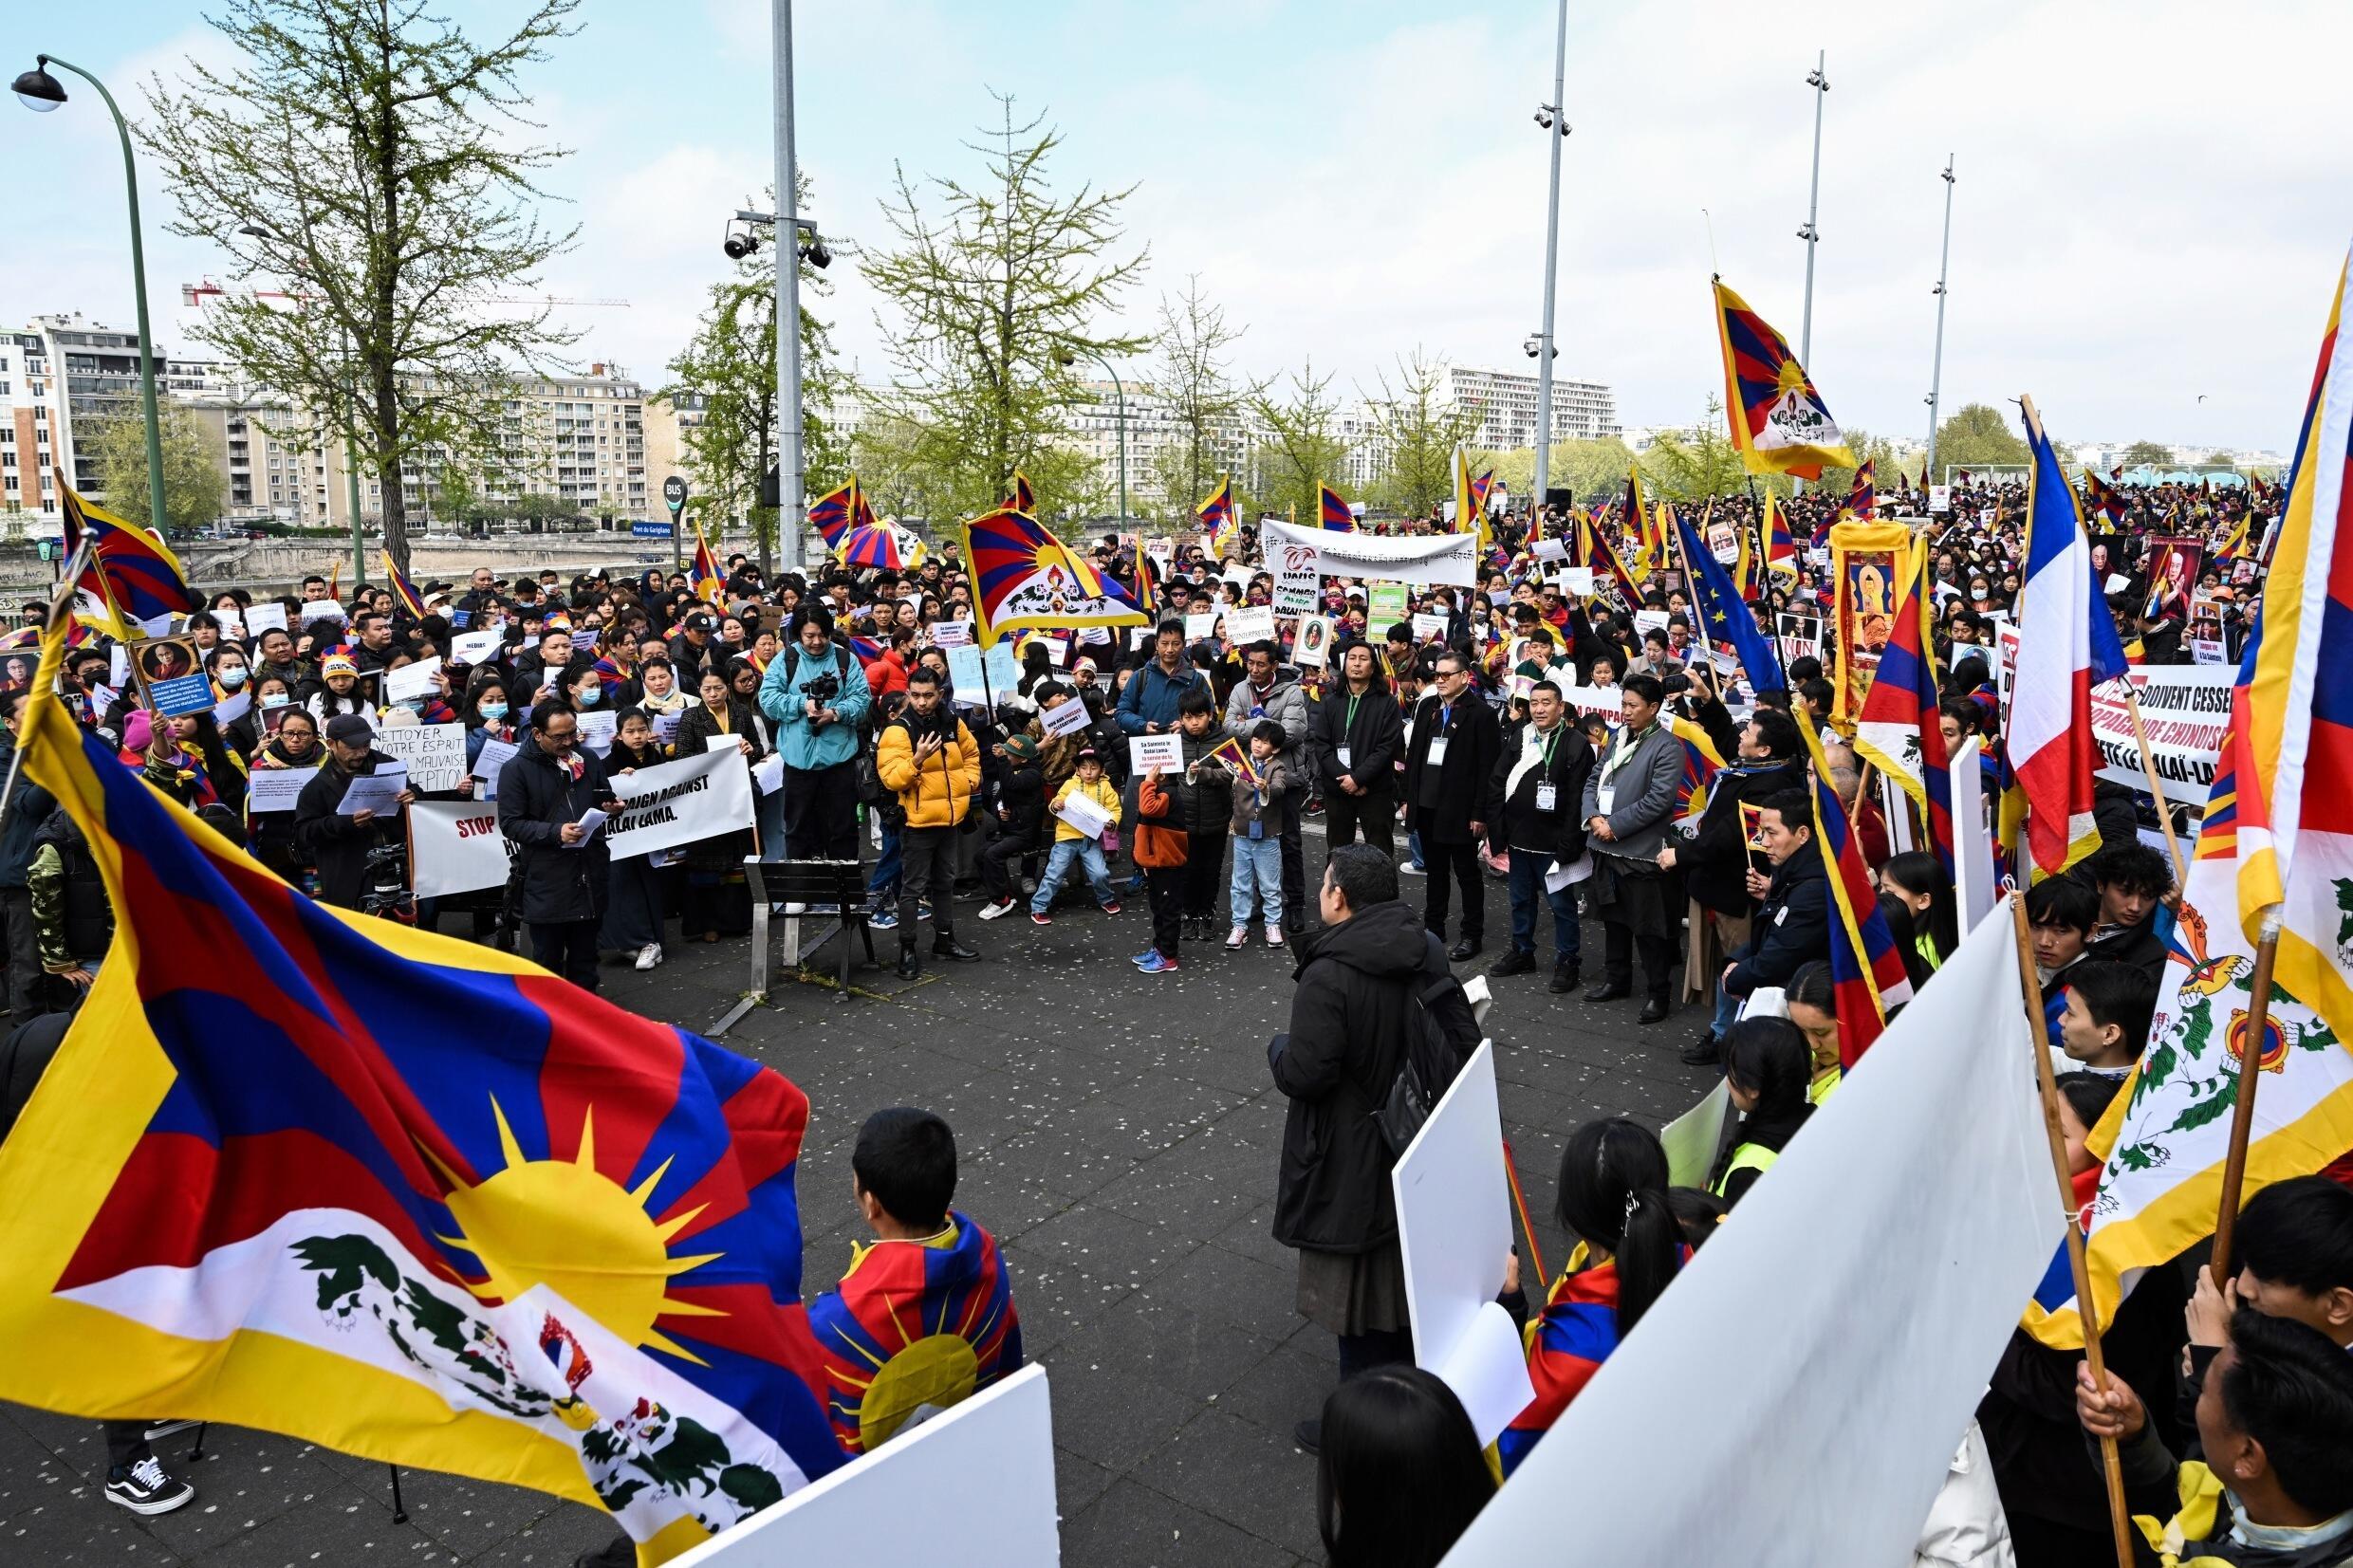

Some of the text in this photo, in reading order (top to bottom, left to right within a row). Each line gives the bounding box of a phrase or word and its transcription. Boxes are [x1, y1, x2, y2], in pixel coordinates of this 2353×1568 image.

[666, 484, 681, 495] BUS
[680, 560, 689, 568] 42
[1784, 637, 1813, 655] NON
[2138, 685, 2192, 711] DOIVENT
[1584, 706, 1626, 724] CAMPAG
[377, 728, 442, 743] NETTOYER
[376, 741, 415, 755] VOTRE
[2123, 747, 2140, 773] LE
[408, 768, 466, 791] CEPTION
[622, 774, 709, 812] PAIGN AGAINST
[455, 815, 495, 839] STOP
[638, 805, 678, 829] LAMA.
